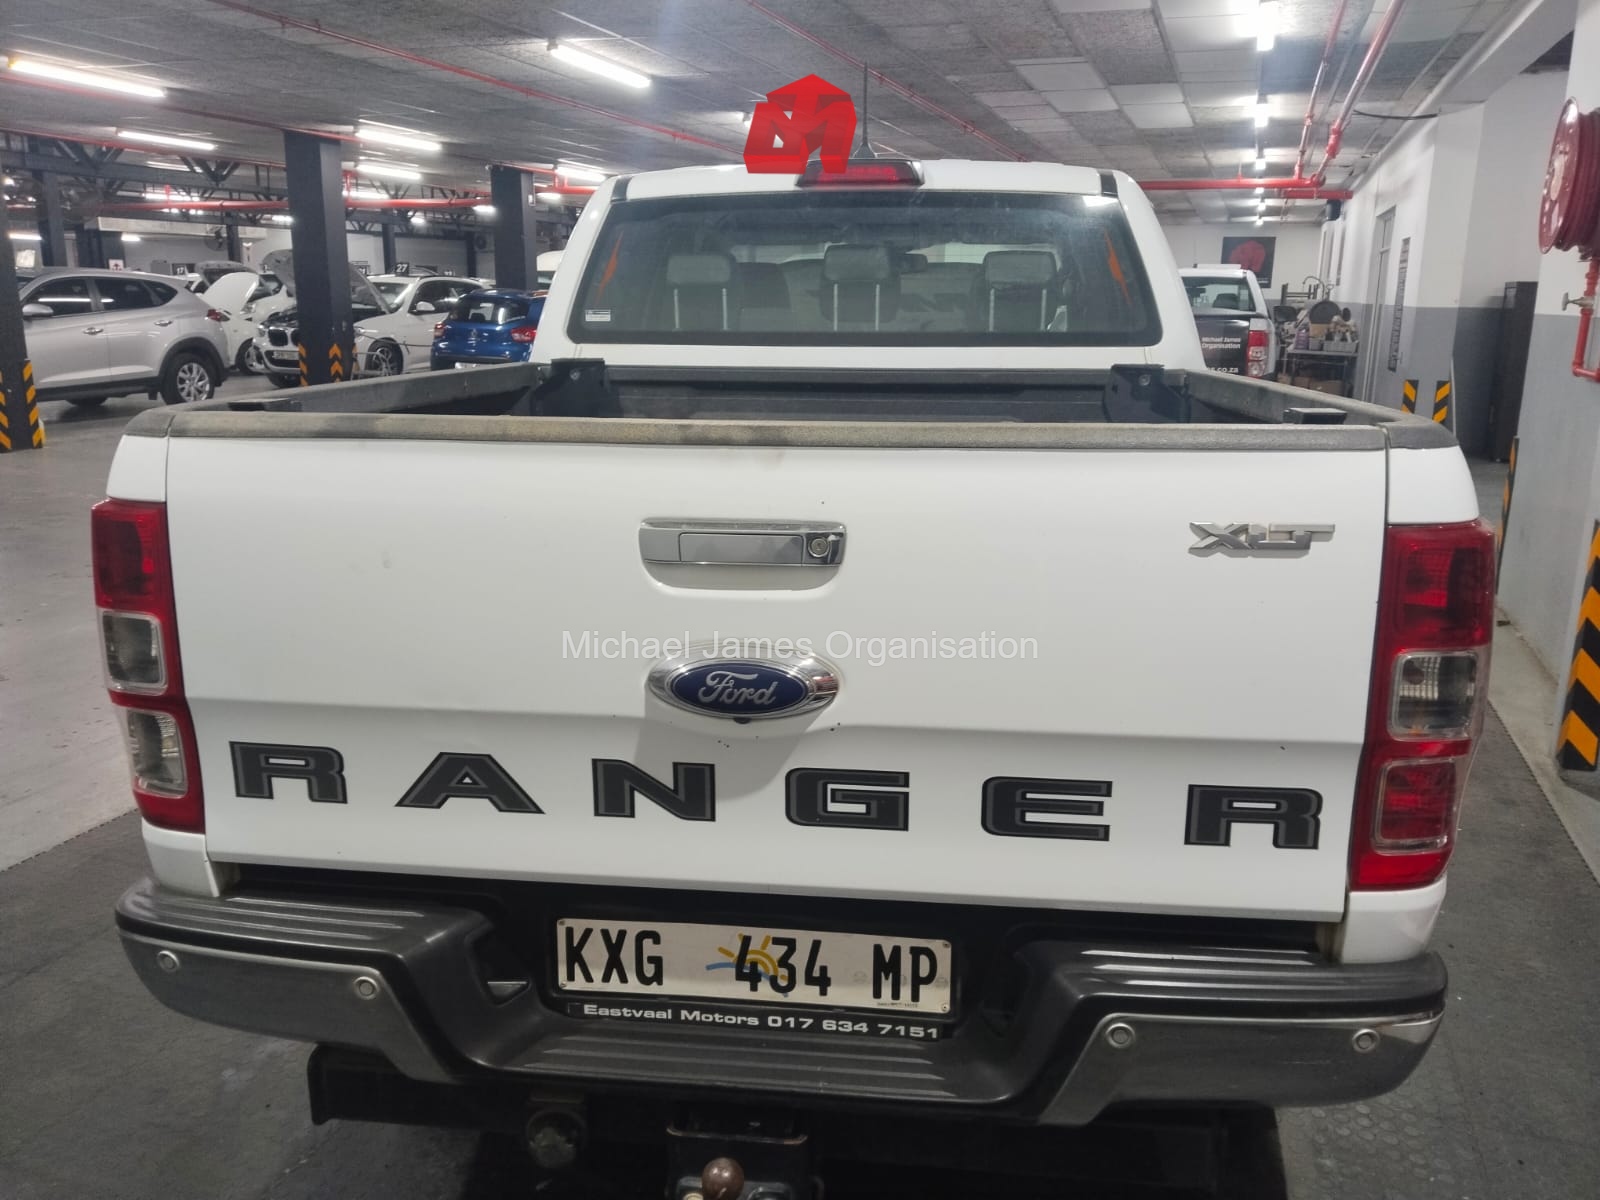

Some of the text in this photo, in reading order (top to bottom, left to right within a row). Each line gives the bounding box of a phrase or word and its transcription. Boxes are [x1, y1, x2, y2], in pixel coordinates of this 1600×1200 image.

[396, 264, 407, 273] 27
[1188, 522, 1335, 558] XLT
[698, 670, 778, 705] Ford
[229, 741, 1323, 850] RANGER
[565, 926, 938, 1003] KXG 434 MP
[584, 1003, 939, 1039] Eastvaal Motors 017 634 7151
